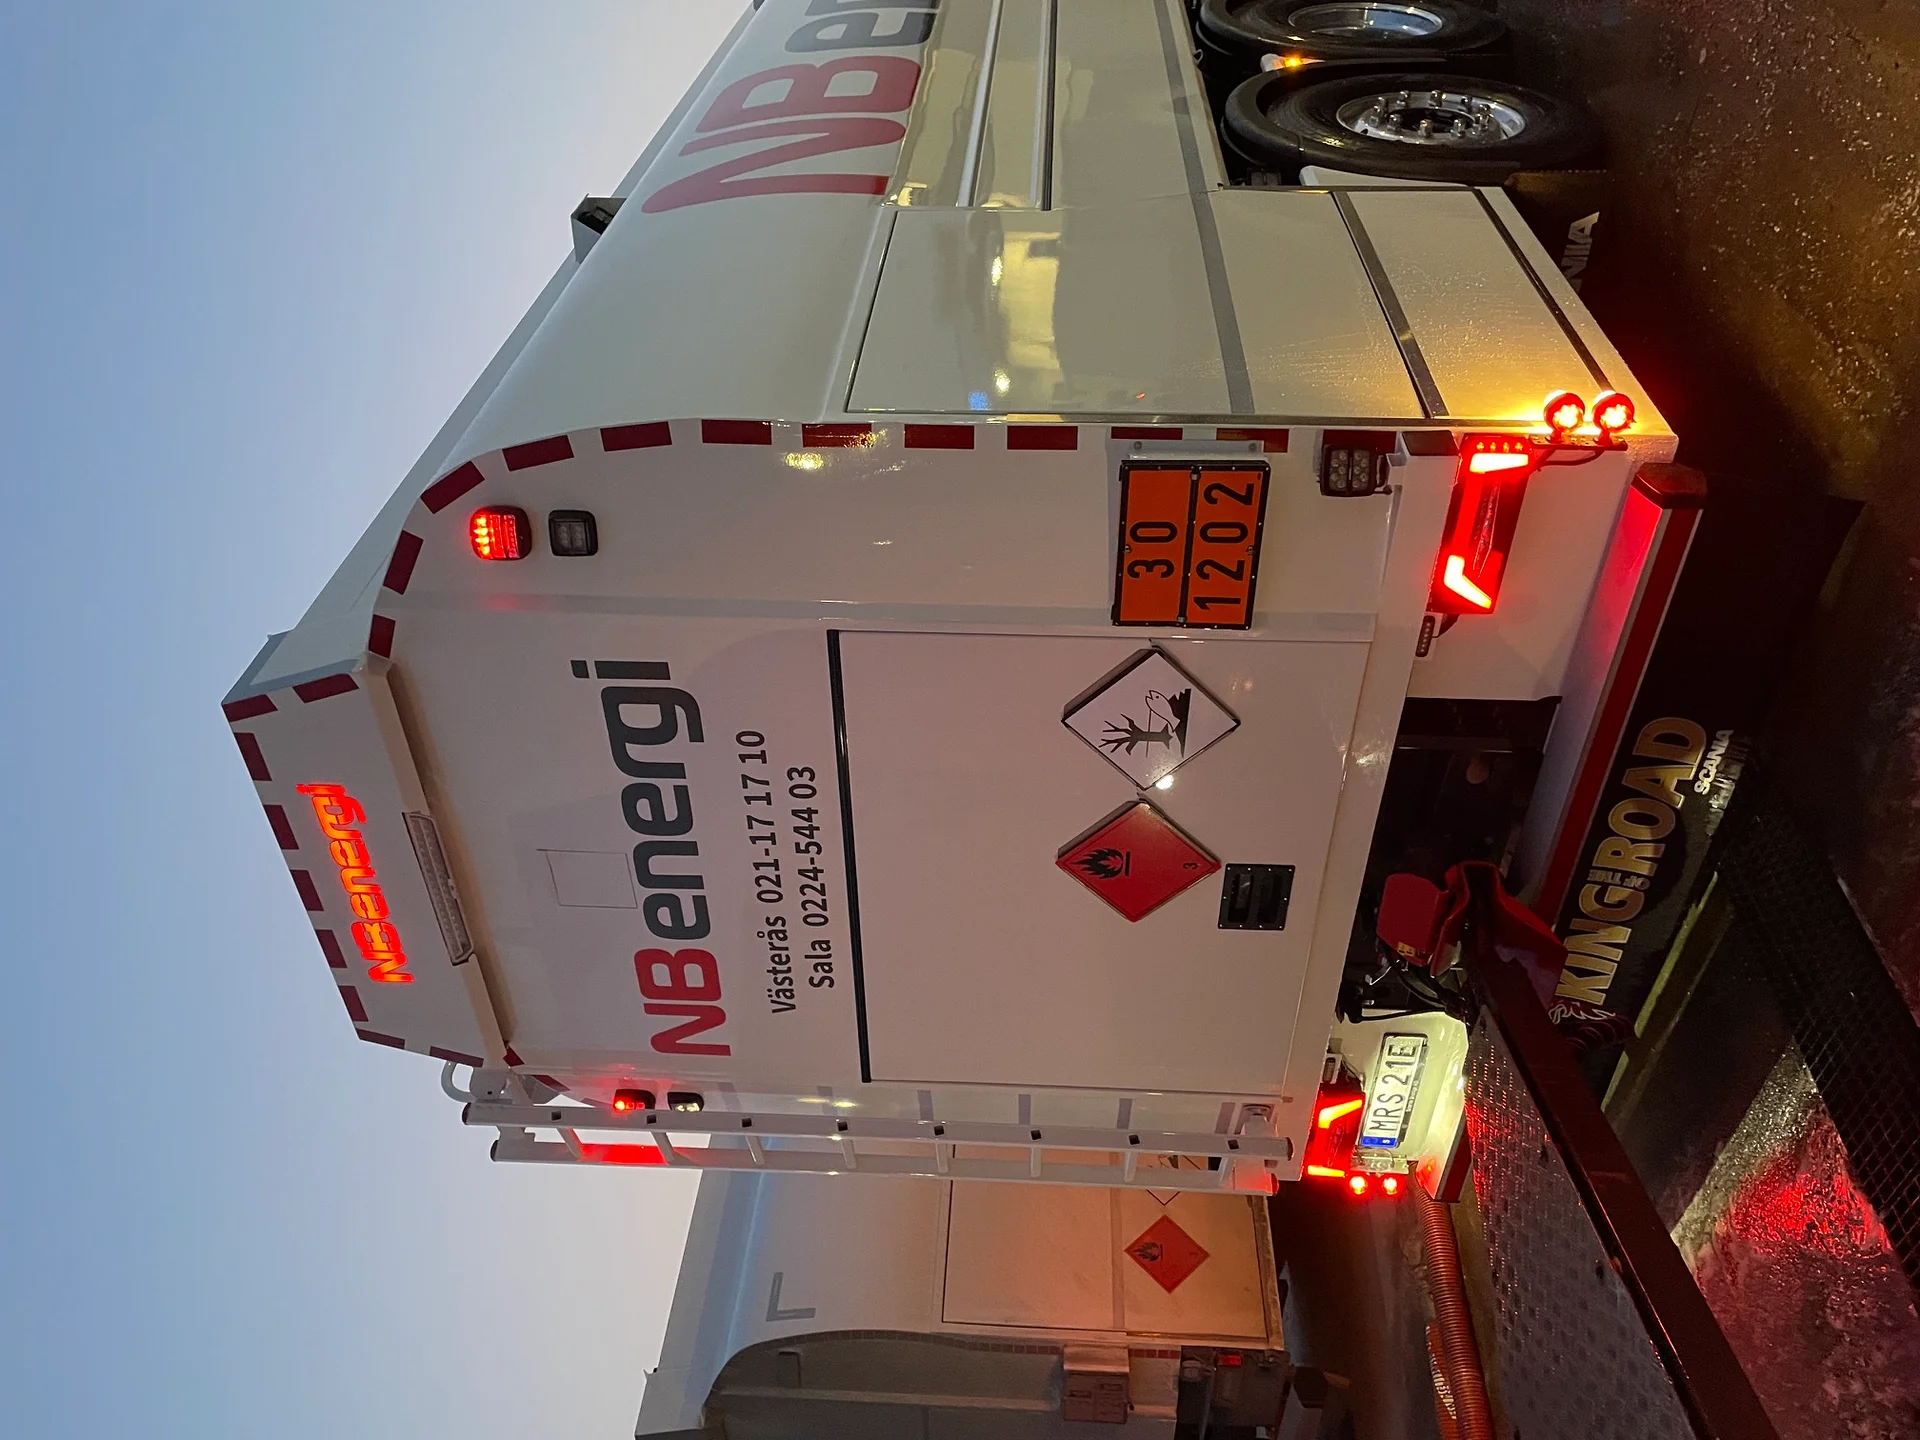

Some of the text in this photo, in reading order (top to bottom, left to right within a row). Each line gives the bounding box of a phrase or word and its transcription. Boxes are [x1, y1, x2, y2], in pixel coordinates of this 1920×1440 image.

[1127, 521, 1178, 578] 30
[1193, 483, 1254, 610] 1202
[1592, 717, 1707, 876] ROAD
[1694, 730, 1734, 795] SCANIA
[295, 783, 415, 983] NBenergi
[570, 660, 731, 1056] NBenergi
[735, 730, 796, 1013] Västerås 021-17 17 10
[786, 766, 835, 988] Sala 0224-544 03
[1554, 884, 1645, 1005] KING
[1369, 1094, 1403, 1131] MRS
[1382, 1045, 1417, 1086] 21E
